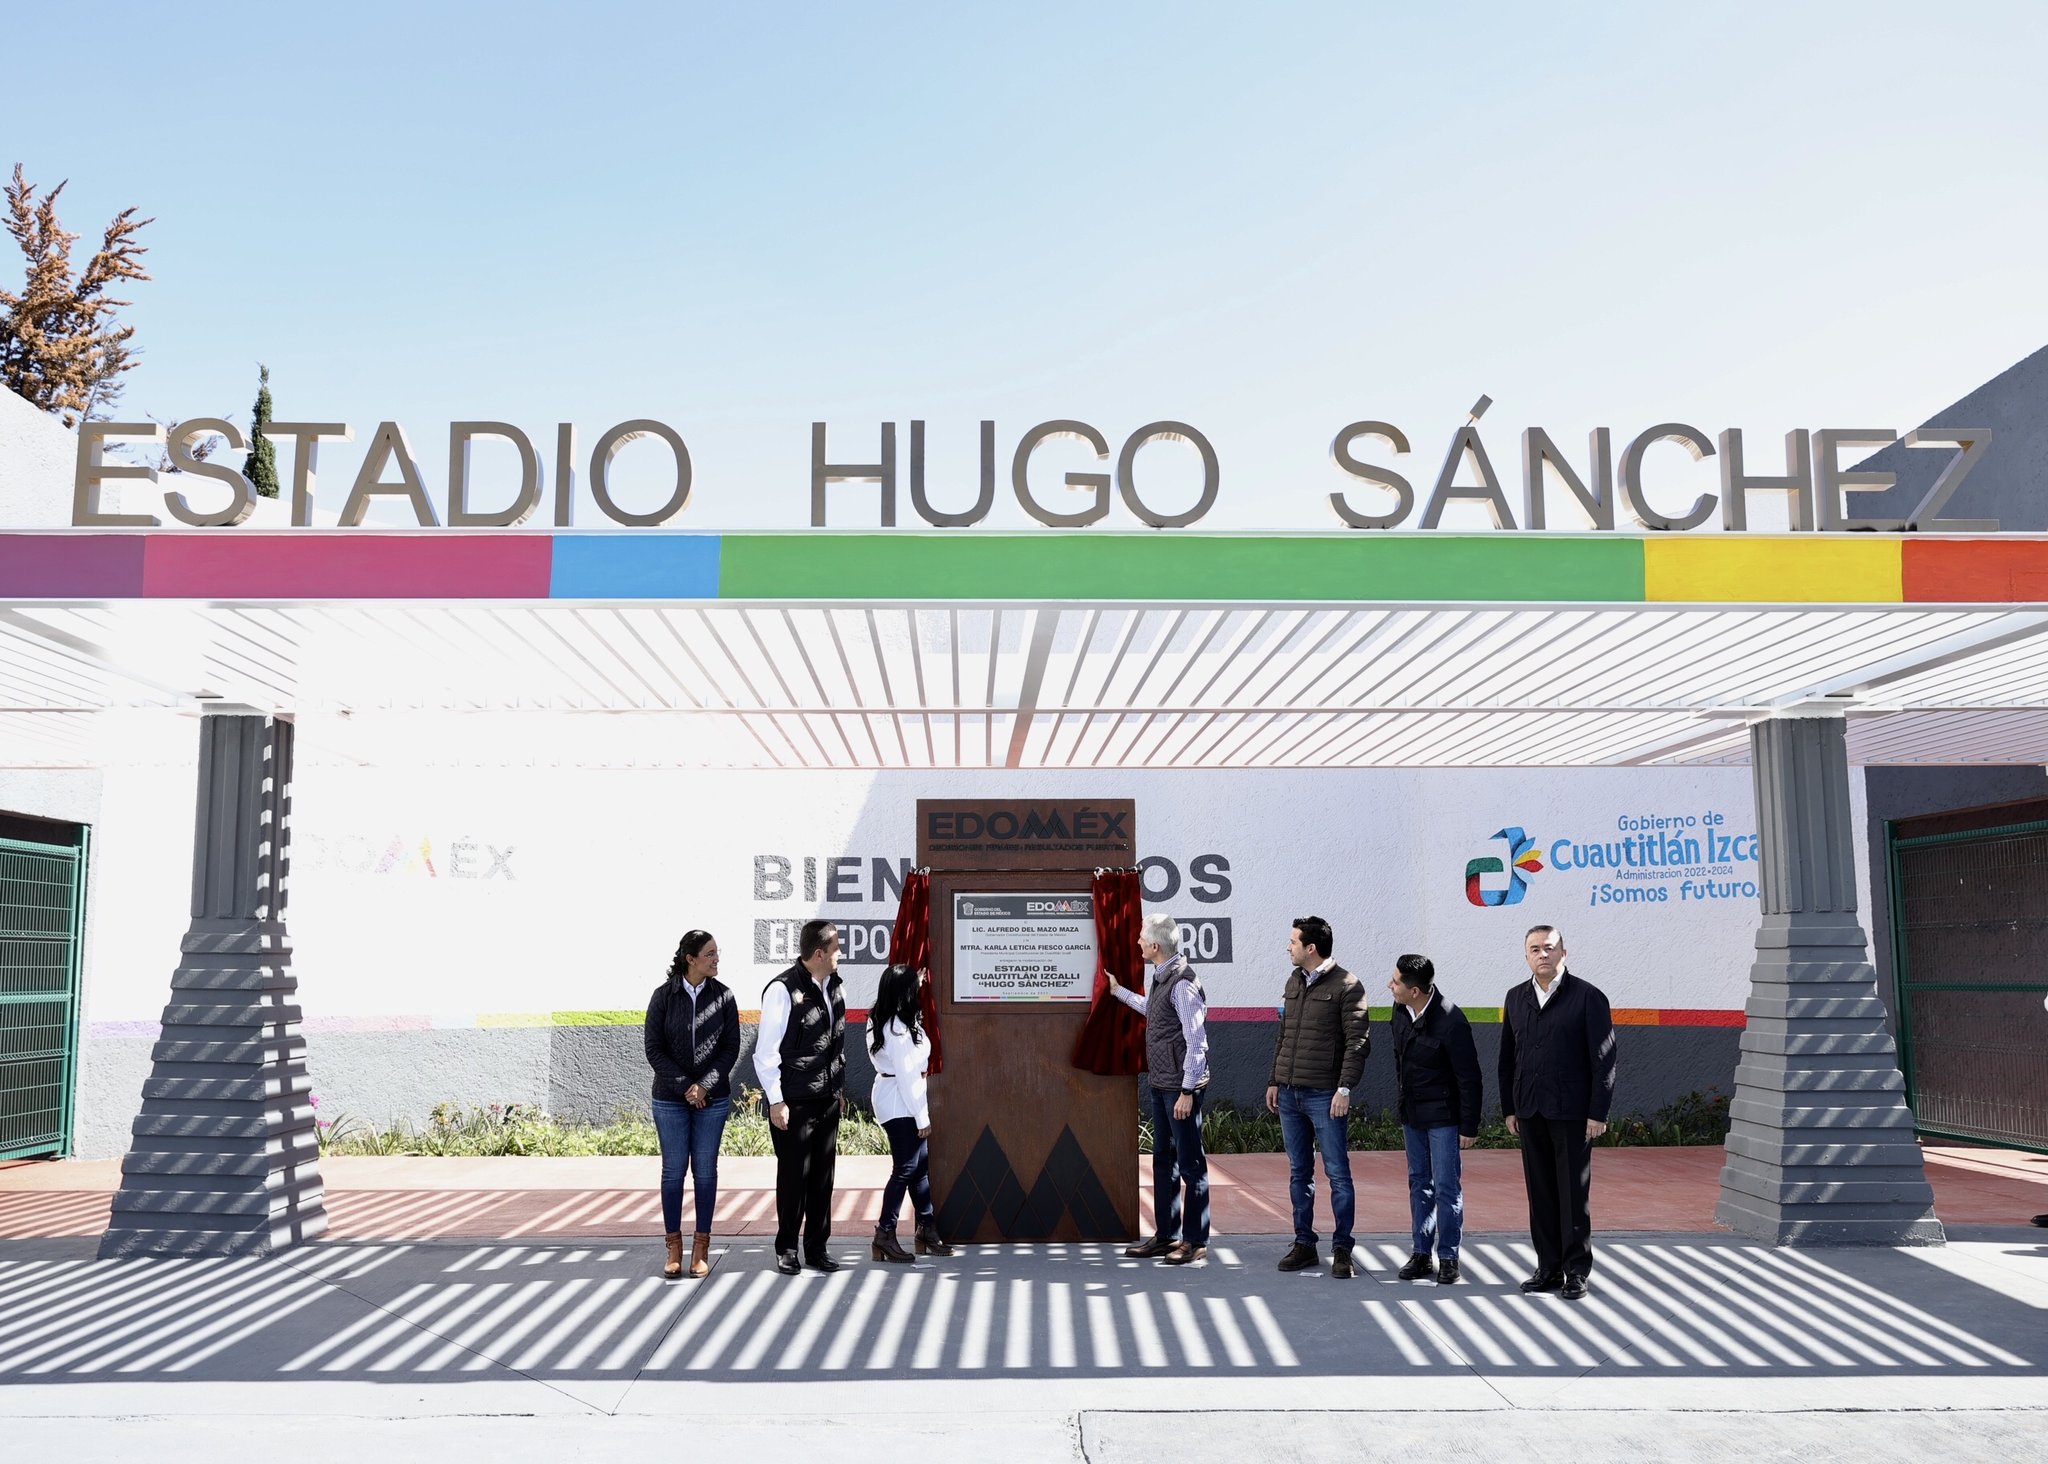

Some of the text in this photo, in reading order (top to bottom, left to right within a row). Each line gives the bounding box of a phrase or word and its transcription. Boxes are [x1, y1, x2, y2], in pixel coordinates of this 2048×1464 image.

[72, 394, 2000, 531] ESTADIO HUGO SÁNCHEZ
[928, 808, 1128, 840] EDOMÉX
[1618, 811, 1724, 831] Gobierno de
[1550, 828, 1759, 871] Cuautitlán Izca
[1026, 900, 1090, 911] EDOMÉX
[1590, 879, 1760, 906] ¡Somos futuro
[972, 972, 1038, 980] CUAUTITLÁN
